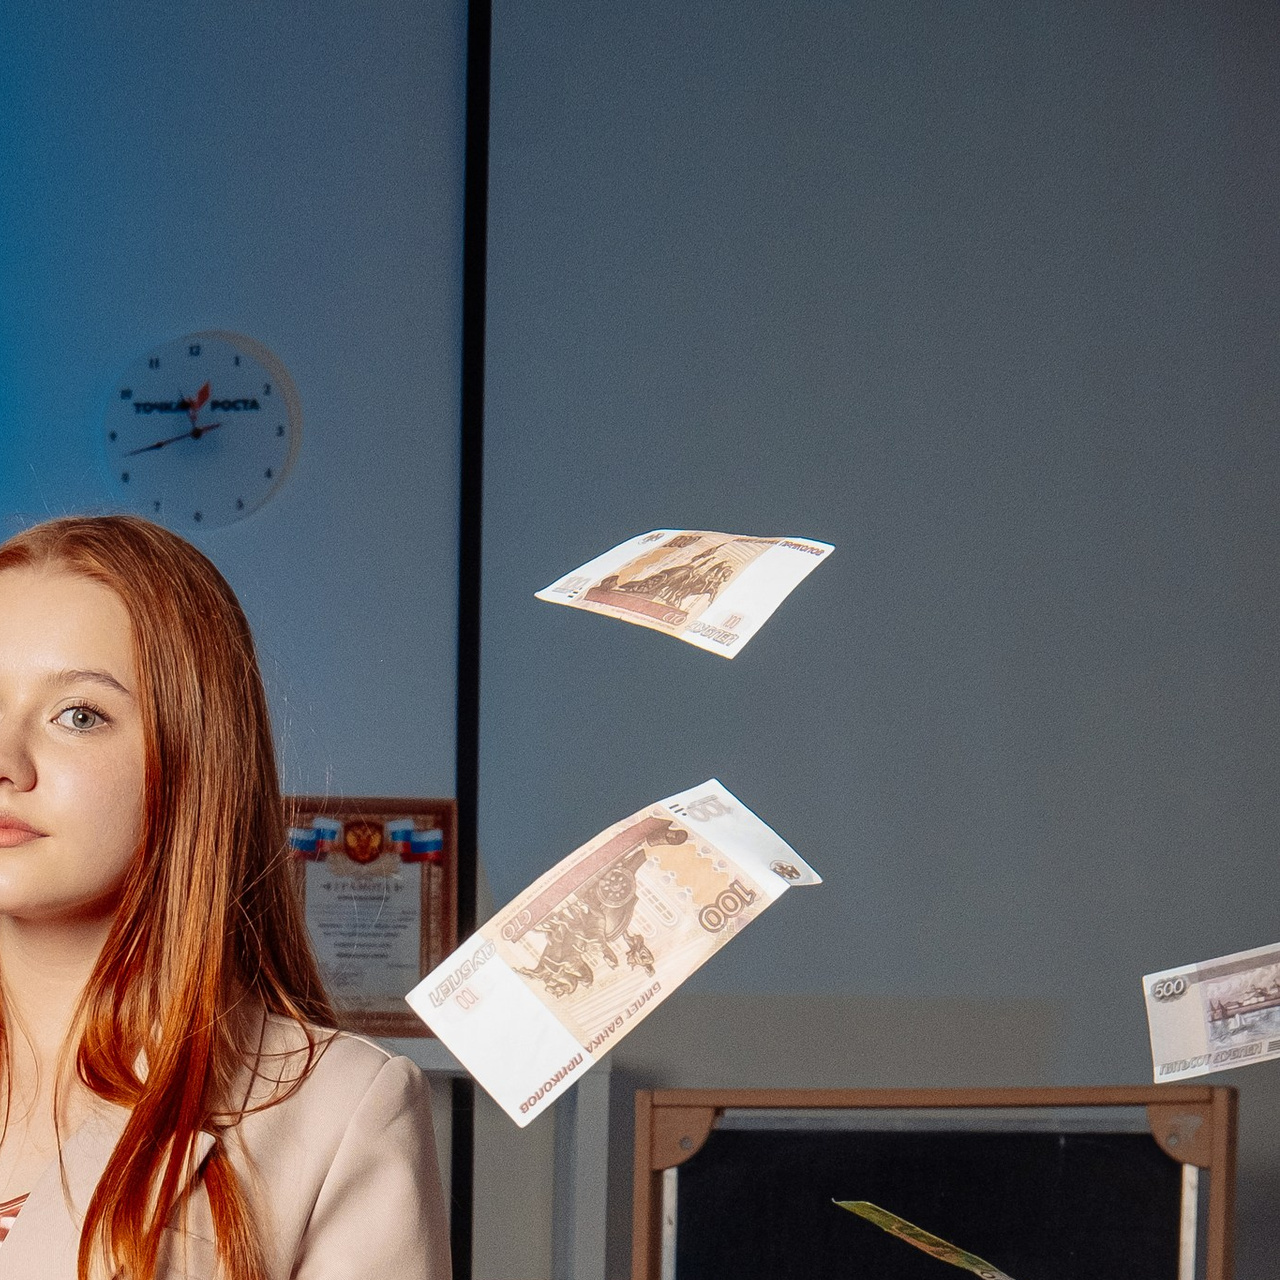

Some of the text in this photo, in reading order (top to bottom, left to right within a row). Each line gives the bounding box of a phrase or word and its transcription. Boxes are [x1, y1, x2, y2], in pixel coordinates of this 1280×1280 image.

[697, 878, 757, 934] 100
[1154, 977, 1185, 999] 500
[519, 981, 663, 1115] БИЛЕТ БАНКА ПРИКОЛОВ
